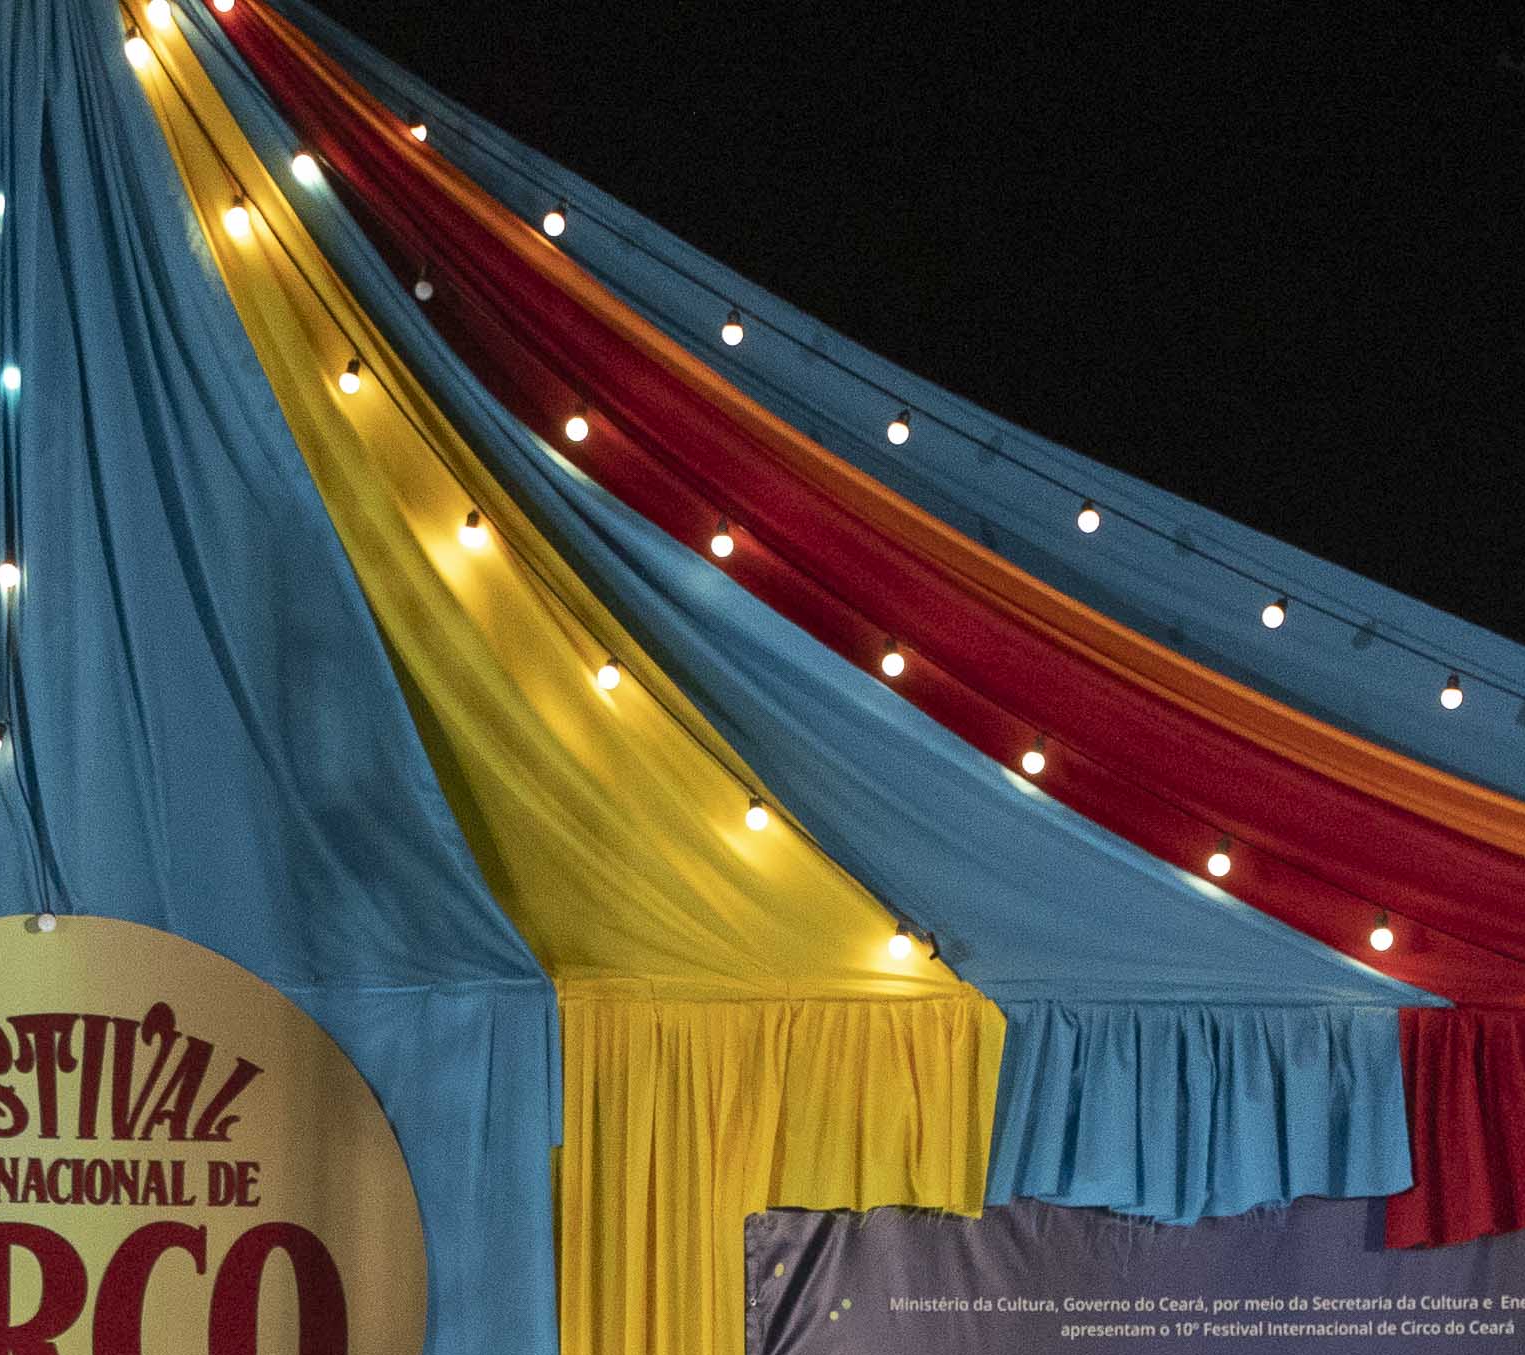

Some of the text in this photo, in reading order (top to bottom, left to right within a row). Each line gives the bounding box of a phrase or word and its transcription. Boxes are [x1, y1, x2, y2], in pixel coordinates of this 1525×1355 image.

[207, 1161, 261, 1207] DE
[889, 1297, 969, 1313] Ministério
[973, 1297, 993, 1312] da
[997, 1297, 1059, 1314] Cultura,
[1063, 1298, 1131, 1312] Governo
[1134, 1297, 1155, 1312] do
[1158, 1296, 1209, 1314] Ceará,
[1213, 1300, 1241, 1315] por
[1245, 1296, 1284, 1311] meio
[1288, 1296, 1308, 1311] da
[1312, 1296, 1392, 1311] Secretaria
[1397, 1295, 1417, 1311] da
[1421, 1295, 1479, 1310] Cultura
[1482, 1299, 1493, 1310] e
[1061, 1324, 1155, 1340] apresentam
[1159, 1325, 1170, 1337] o
[1203, 1321, 1263, 1337] Festival
[1267, 1321, 1373, 1337] Internacional
[1377, 1320, 1397, 1336] de
[1401, 1320, 1441, 1336] Circo
[1445, 1320, 1465, 1335] do
[1469, 1320, 1515, 1335] Ceará
